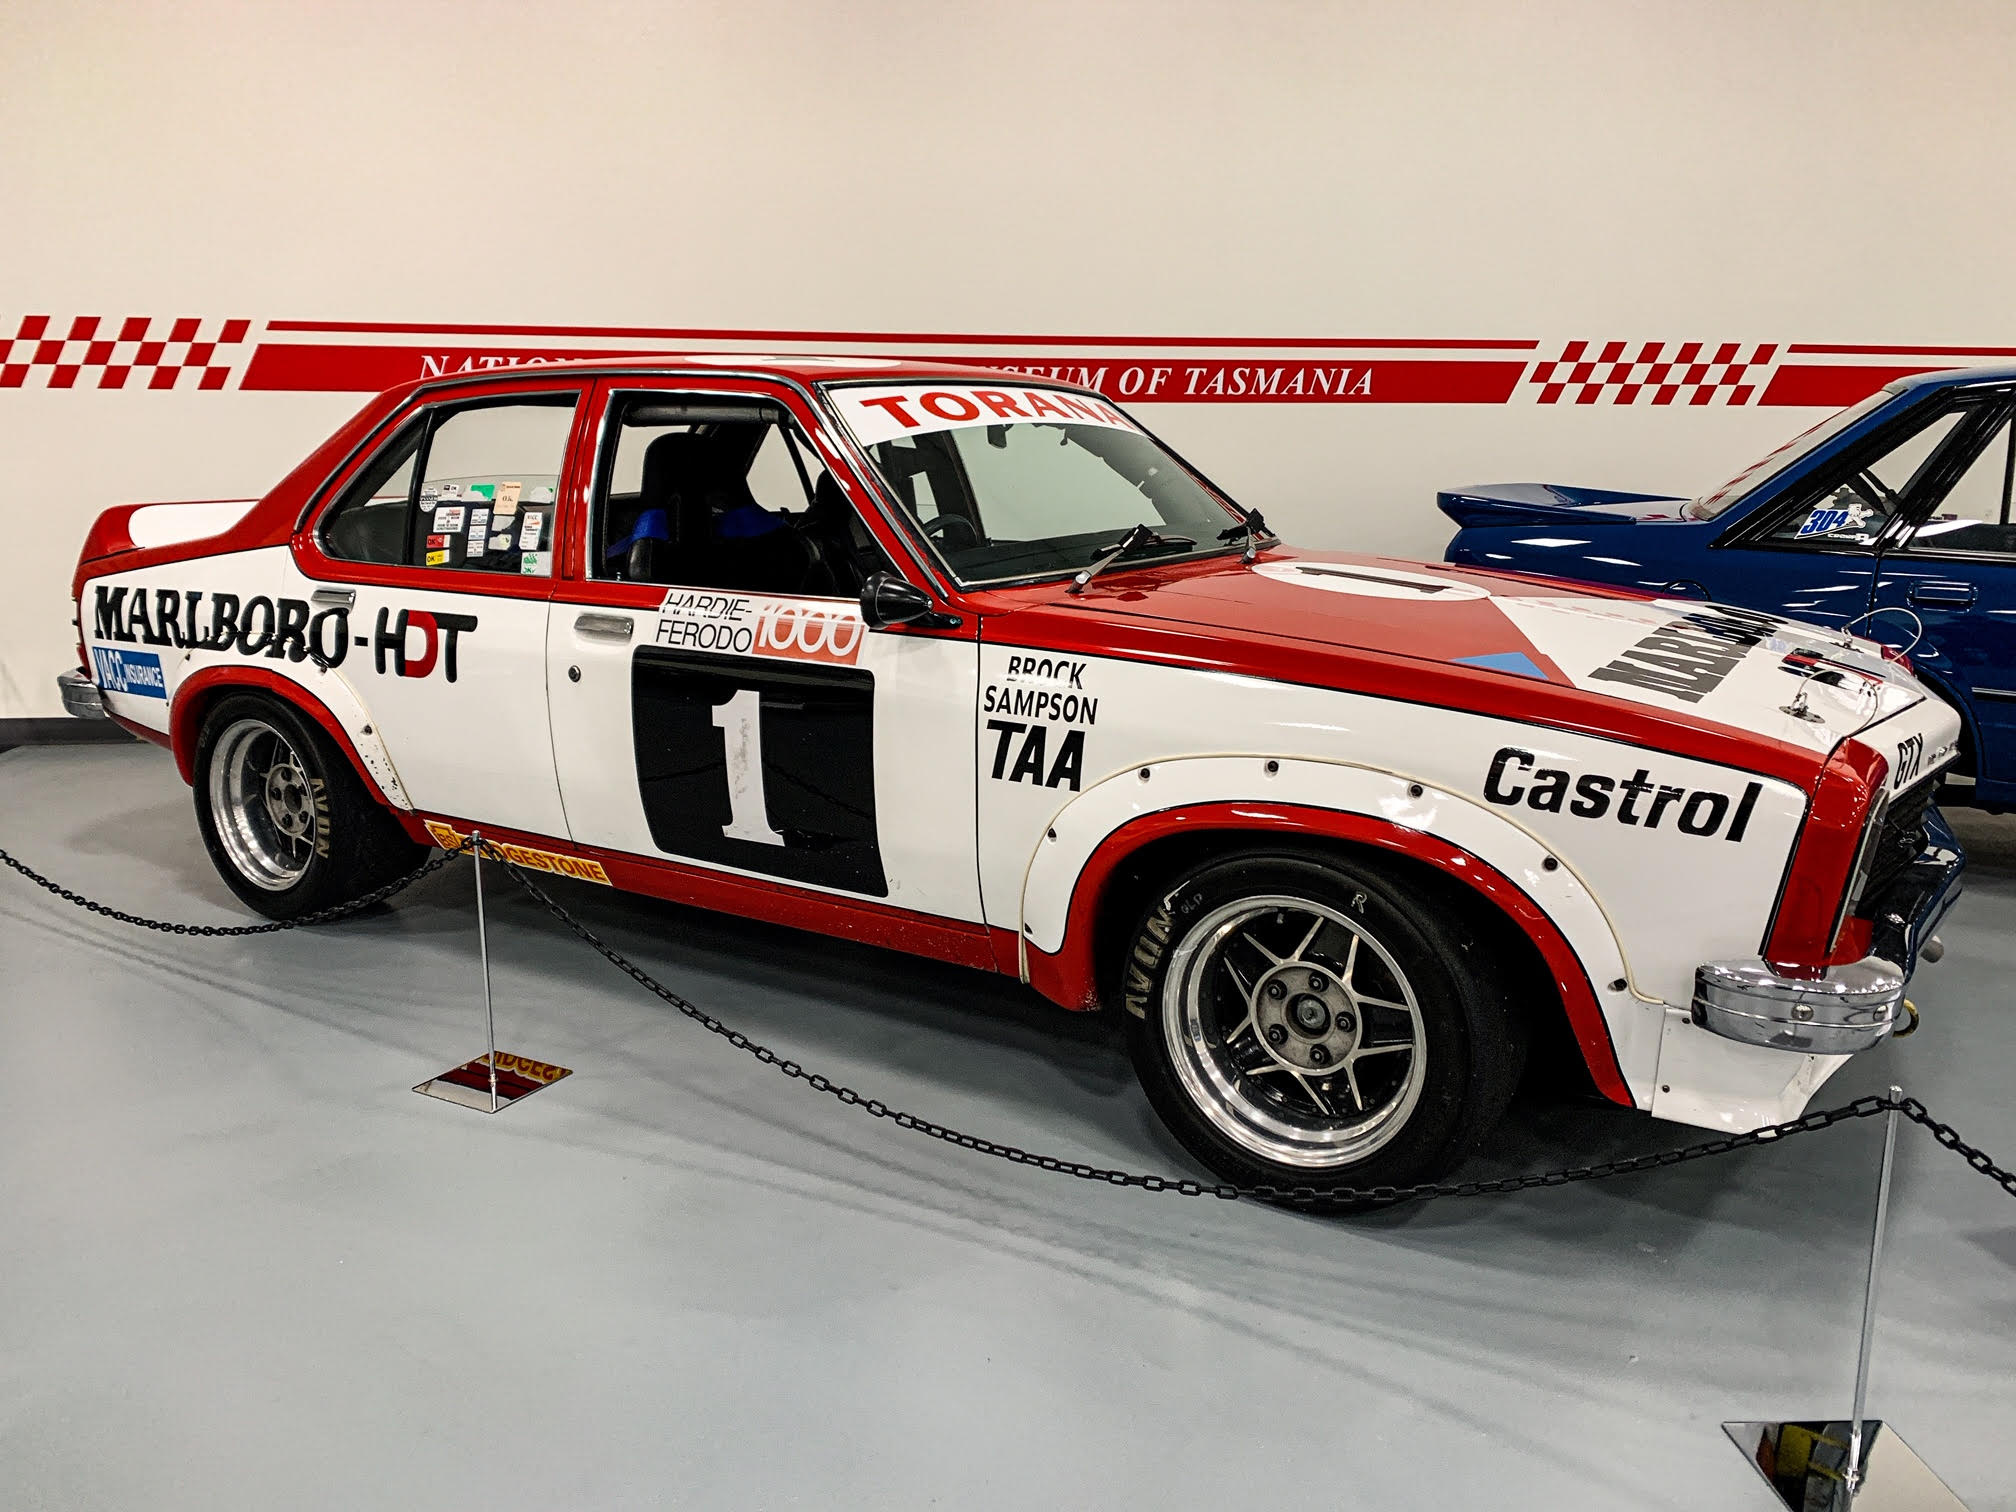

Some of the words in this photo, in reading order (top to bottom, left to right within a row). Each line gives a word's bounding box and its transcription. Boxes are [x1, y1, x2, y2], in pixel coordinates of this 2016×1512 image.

[1118, 366, 1172, 395] OF
[1184, 367, 1372, 395] TASMANIA
[859, 391, 1133, 428] TORANA
[1801, 510, 1849, 534] 304
[655, 619, 752, 653] FERODO
[756, 604, 860, 656] 1000
[94, 648, 128, 692] VACC
[122, 663, 164, 688] INSURANCE
[1006, 656, 1087, 690] BROCK
[983, 685, 1098, 725] SAMPSON
[711, 689, 786, 847] 1
[986, 719, 1086, 792] TAA
[1894, 732, 1923, 790] GTX
[309, 778, 331, 858] AVON
[1483, 747, 1764, 843] Castrol
[458, 836, 607, 881] GESTONE
[1124, 904, 1177, 1019] AVON
